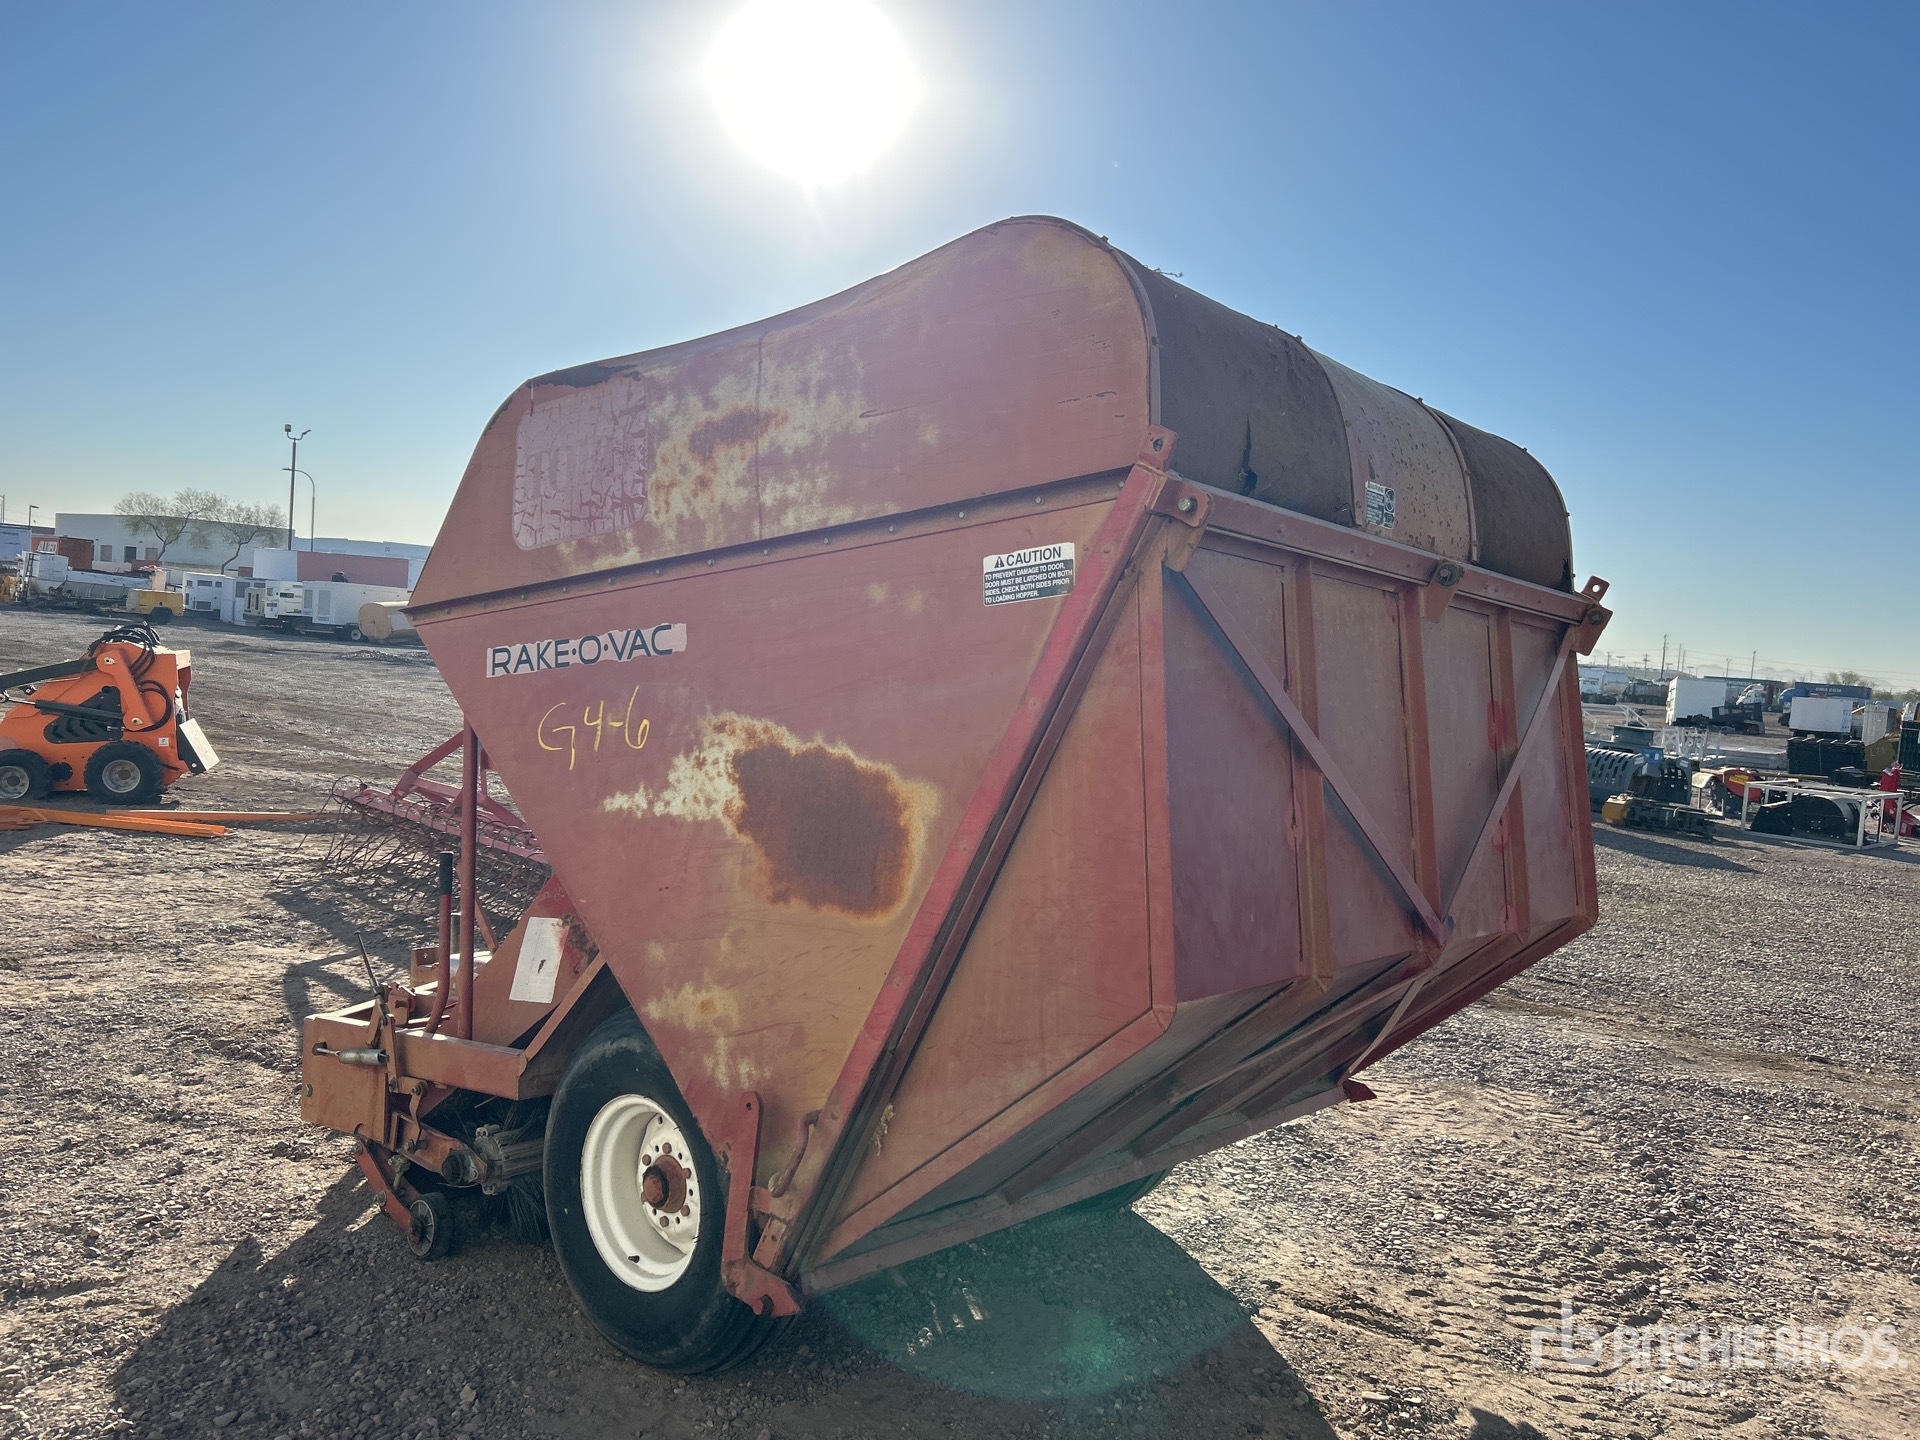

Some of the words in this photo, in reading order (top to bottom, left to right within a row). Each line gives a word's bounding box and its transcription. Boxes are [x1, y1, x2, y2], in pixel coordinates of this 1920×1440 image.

[1006, 546, 1061, 566] CAUTION
[992, 571, 1016, 579] PREVENT
[1017, 567, 1039, 575] DAMAGE
[1000, 578, 1014, 586] MUST
[1023, 573, 1047, 582] LATCHED
[1057, 569, 1072, 577] BOTH
[1001, 585, 1019, 594] CHECK
[1036, 580, 1051, 588] SIDES
[1052, 578, 1069, 586] PRIOR
[992, 593, 1015, 603] LOADING
[1016, 590, 1039, 599] HOPPER.
